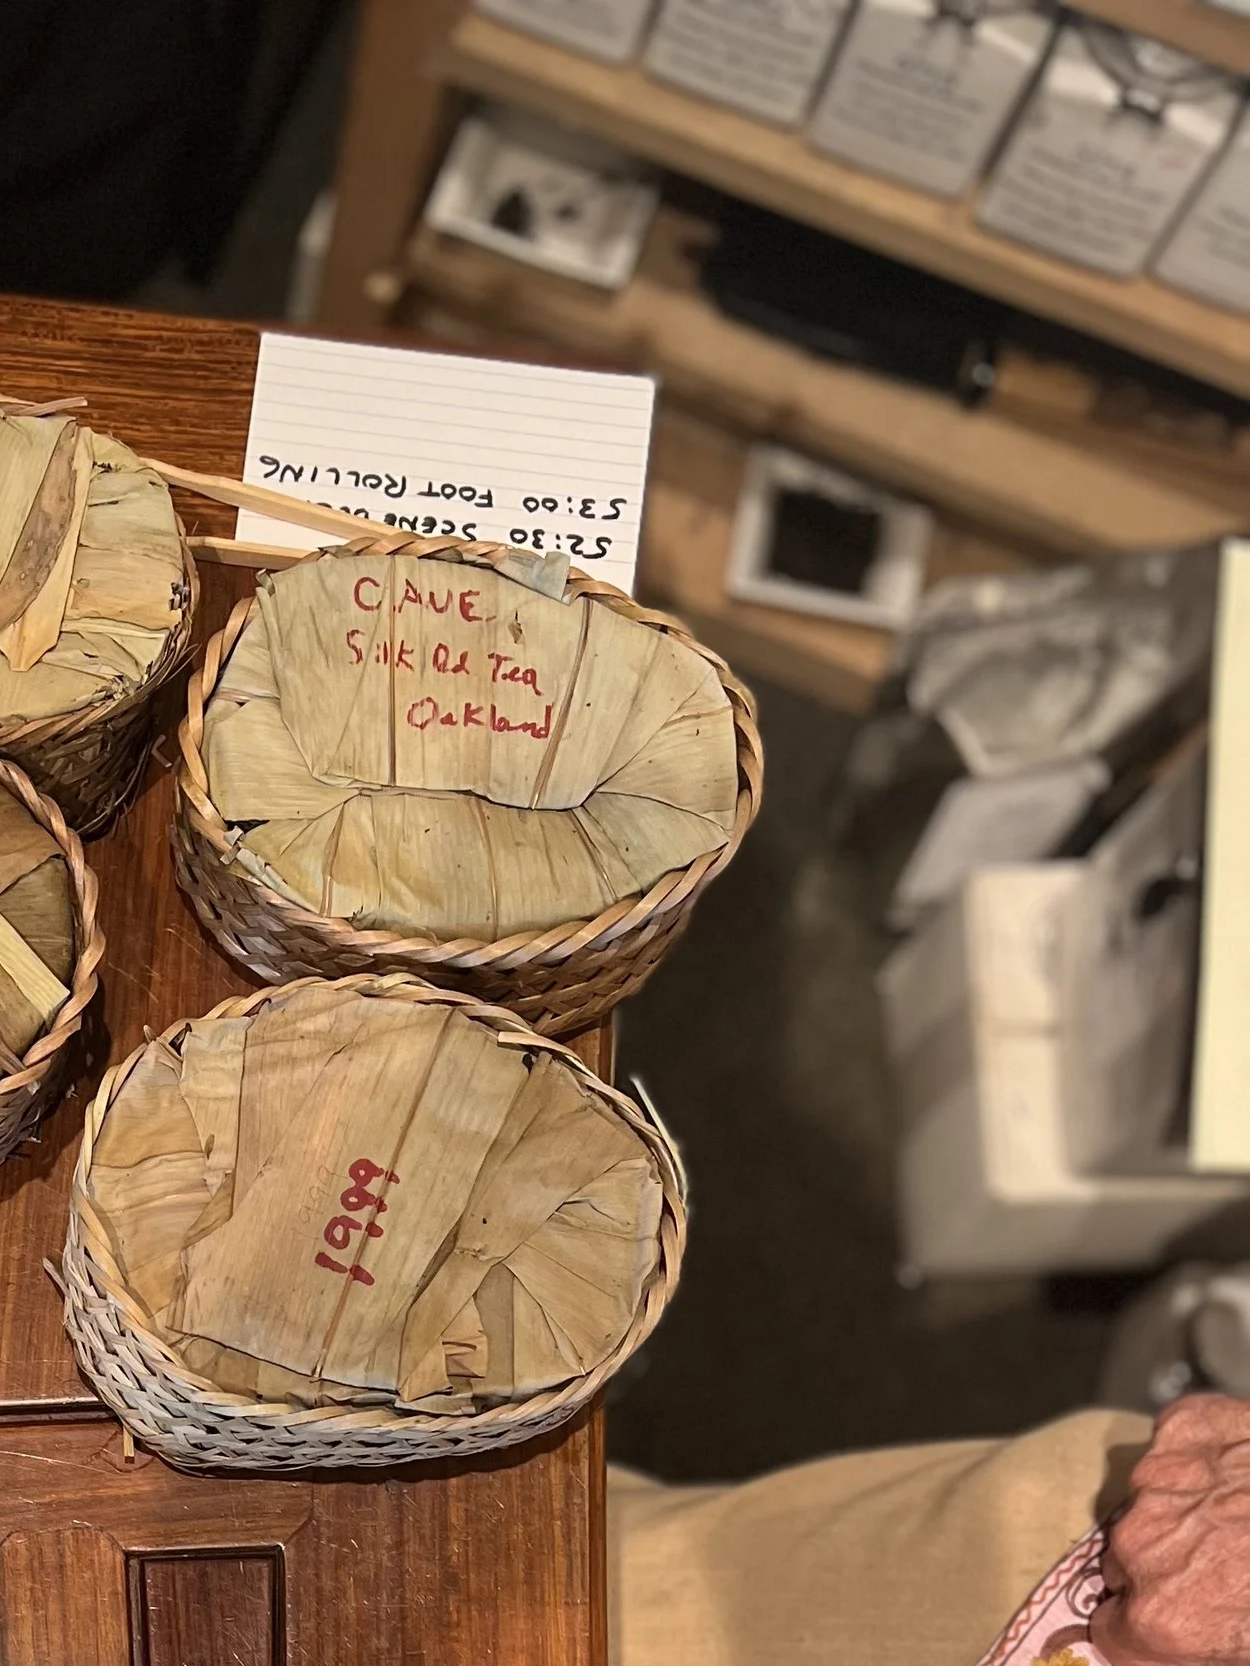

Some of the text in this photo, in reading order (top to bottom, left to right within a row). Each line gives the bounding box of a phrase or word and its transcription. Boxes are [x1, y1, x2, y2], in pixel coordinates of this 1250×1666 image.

[259, 455, 627, 520] 53:00 FOOT ROLLING
[510, 528, 612, 559] 52:30
[354, 576, 483, 622] CAVE
[346, 629, 415, 672] Silk
[487, 652, 544, 696] Tea
[406, 696, 554, 739] Oakland
[314, 1158, 401, 1286] 1999
